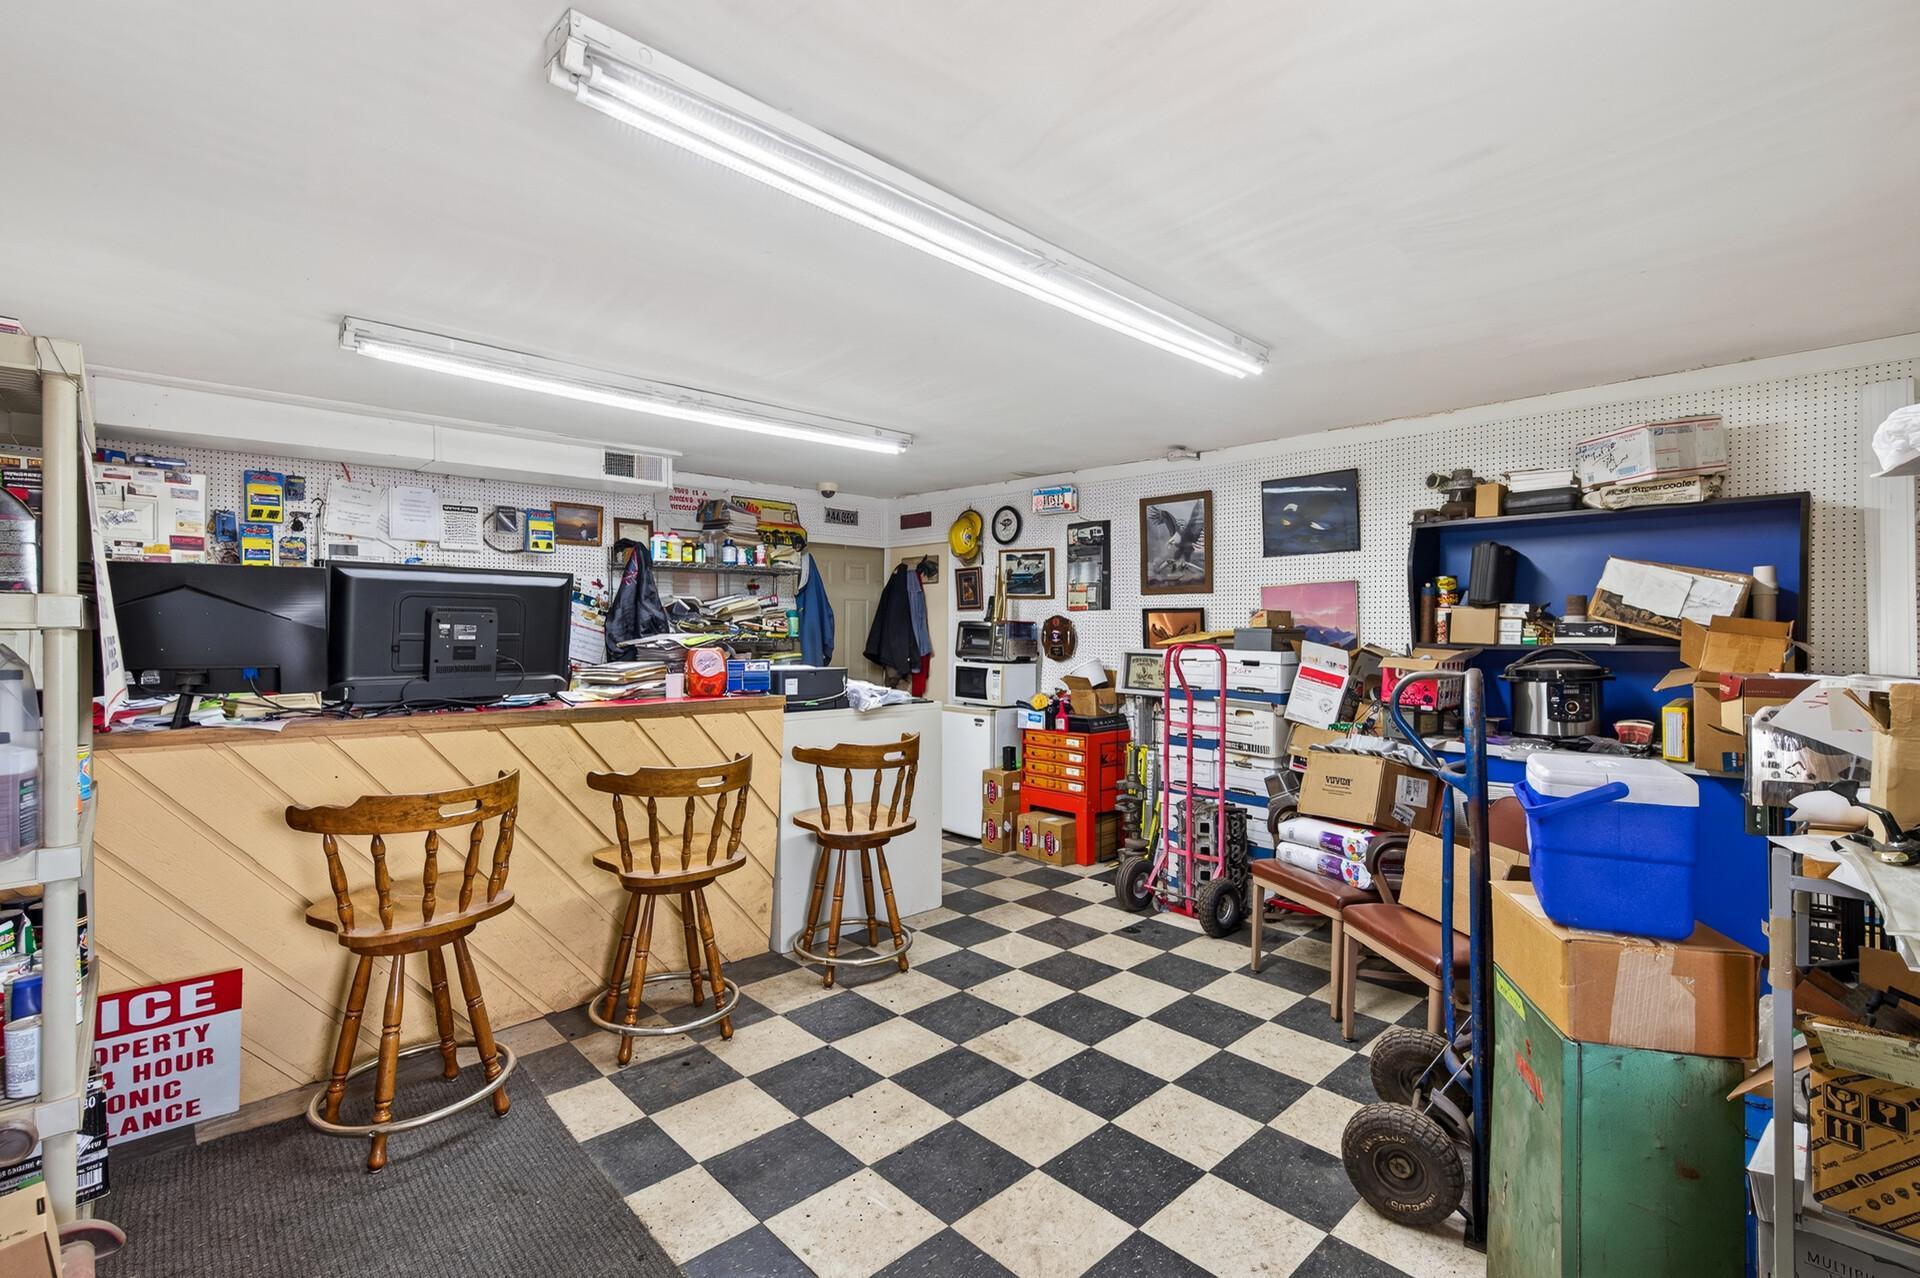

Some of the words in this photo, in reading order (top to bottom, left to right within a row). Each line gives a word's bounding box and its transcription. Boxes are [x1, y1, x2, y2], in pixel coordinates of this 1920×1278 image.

[101, 980, 216, 1034] ICE
[95, 1023, 211, 1067] OPERTY
[133, 1047, 214, 1083] HOUR
[107, 1080, 181, 1114] ONIC
